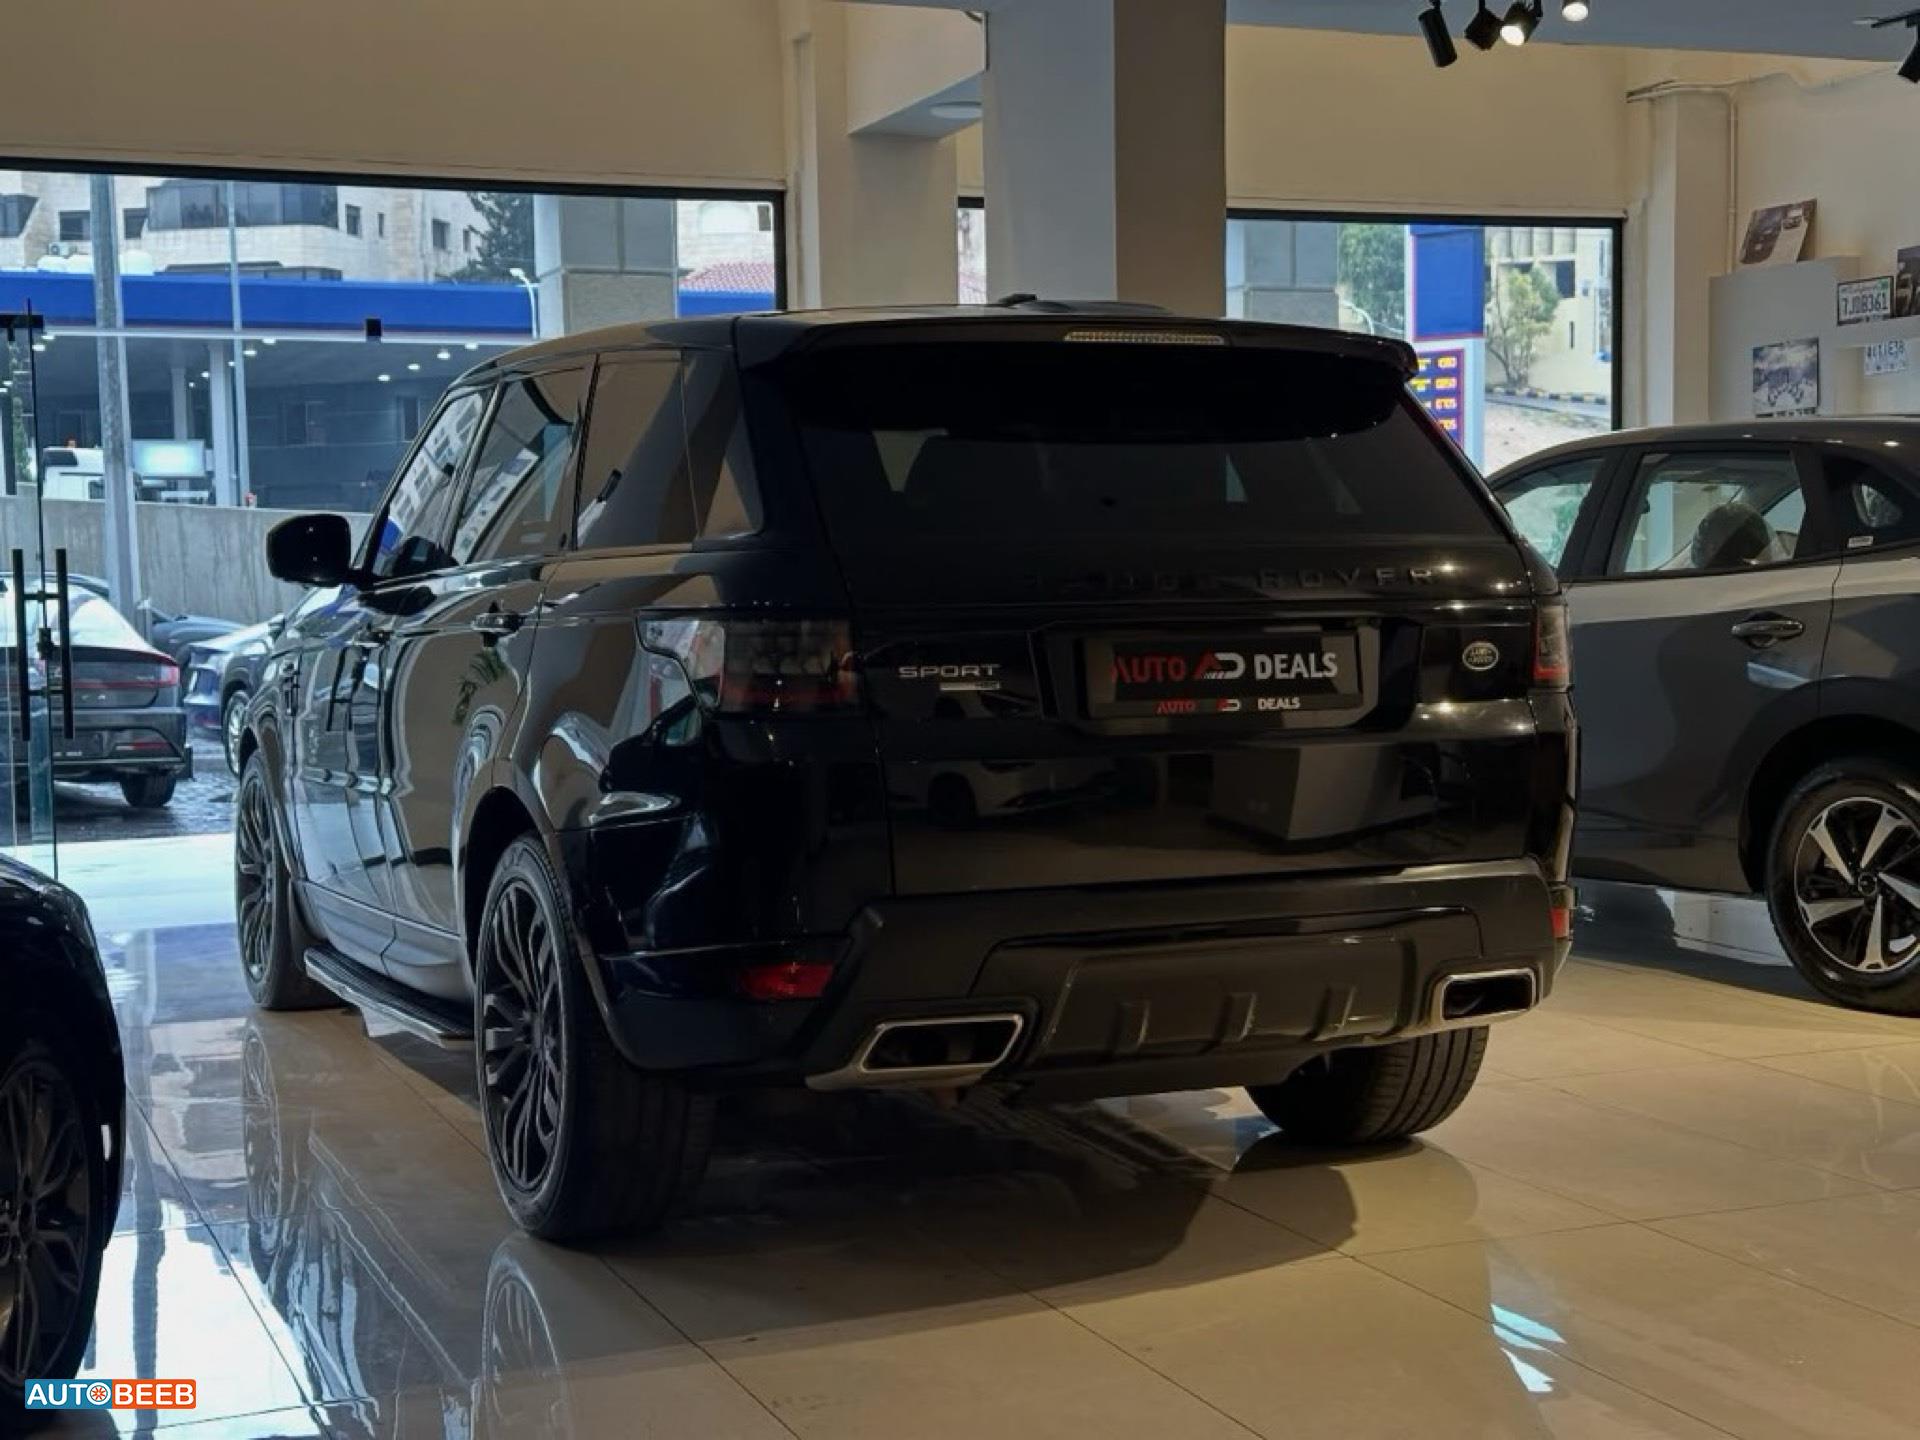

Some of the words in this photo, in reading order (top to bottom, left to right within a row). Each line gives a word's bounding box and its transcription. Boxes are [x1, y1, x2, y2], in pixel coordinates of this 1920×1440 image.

[898, 663, 1001, 678] SPORT
[1111, 652, 1186, 684] AUTO
[1254, 651, 1338, 680] DEALS
[1155, 698, 1197, 714] AUTO
[1257, 697, 1301, 711] DEALS
